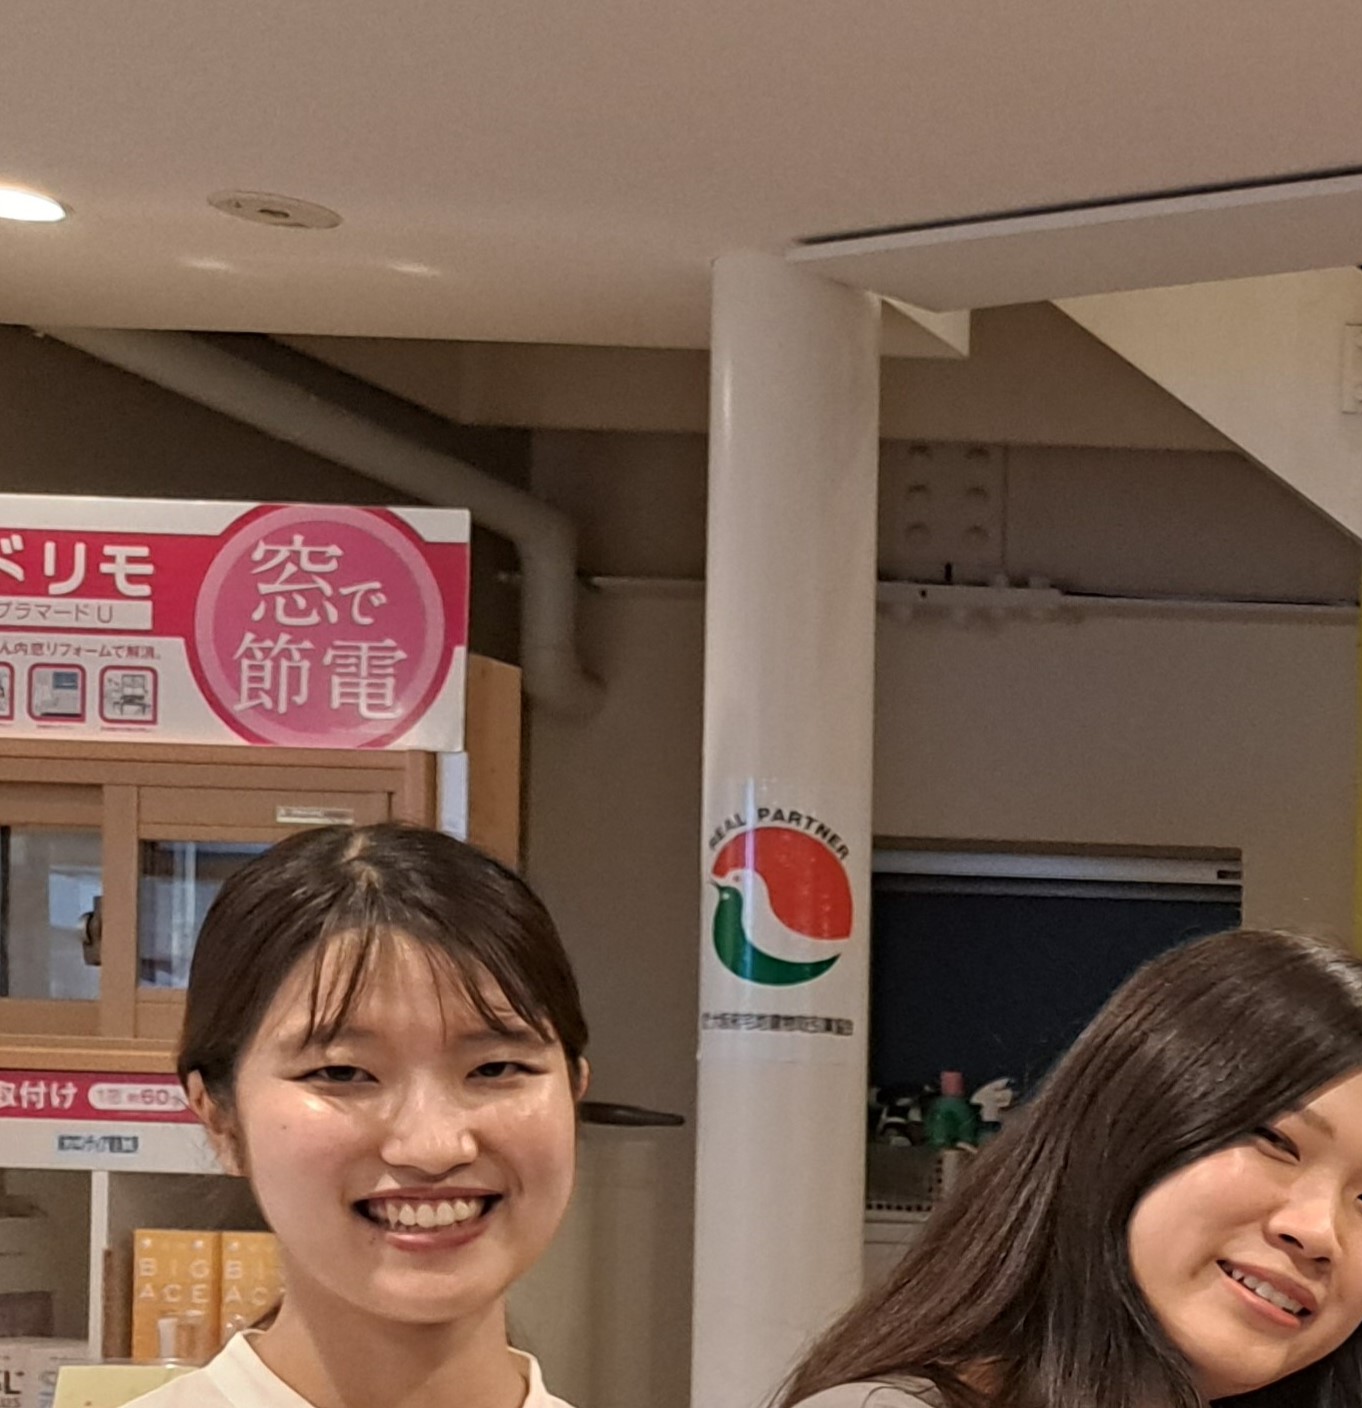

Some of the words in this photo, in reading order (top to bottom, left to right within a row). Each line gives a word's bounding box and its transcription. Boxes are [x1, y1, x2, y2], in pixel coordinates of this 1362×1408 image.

[249, 534, 388, 627] 窓で
[233, 632, 408, 721] 節電
[709, 812, 747, 851] REAL
[757, 807, 850, 861] PARTNER
[139, 1258, 210, 1279] BIG
[139, 1283, 210, 1304] ACE
[225, 1285, 287, 1306] AC
